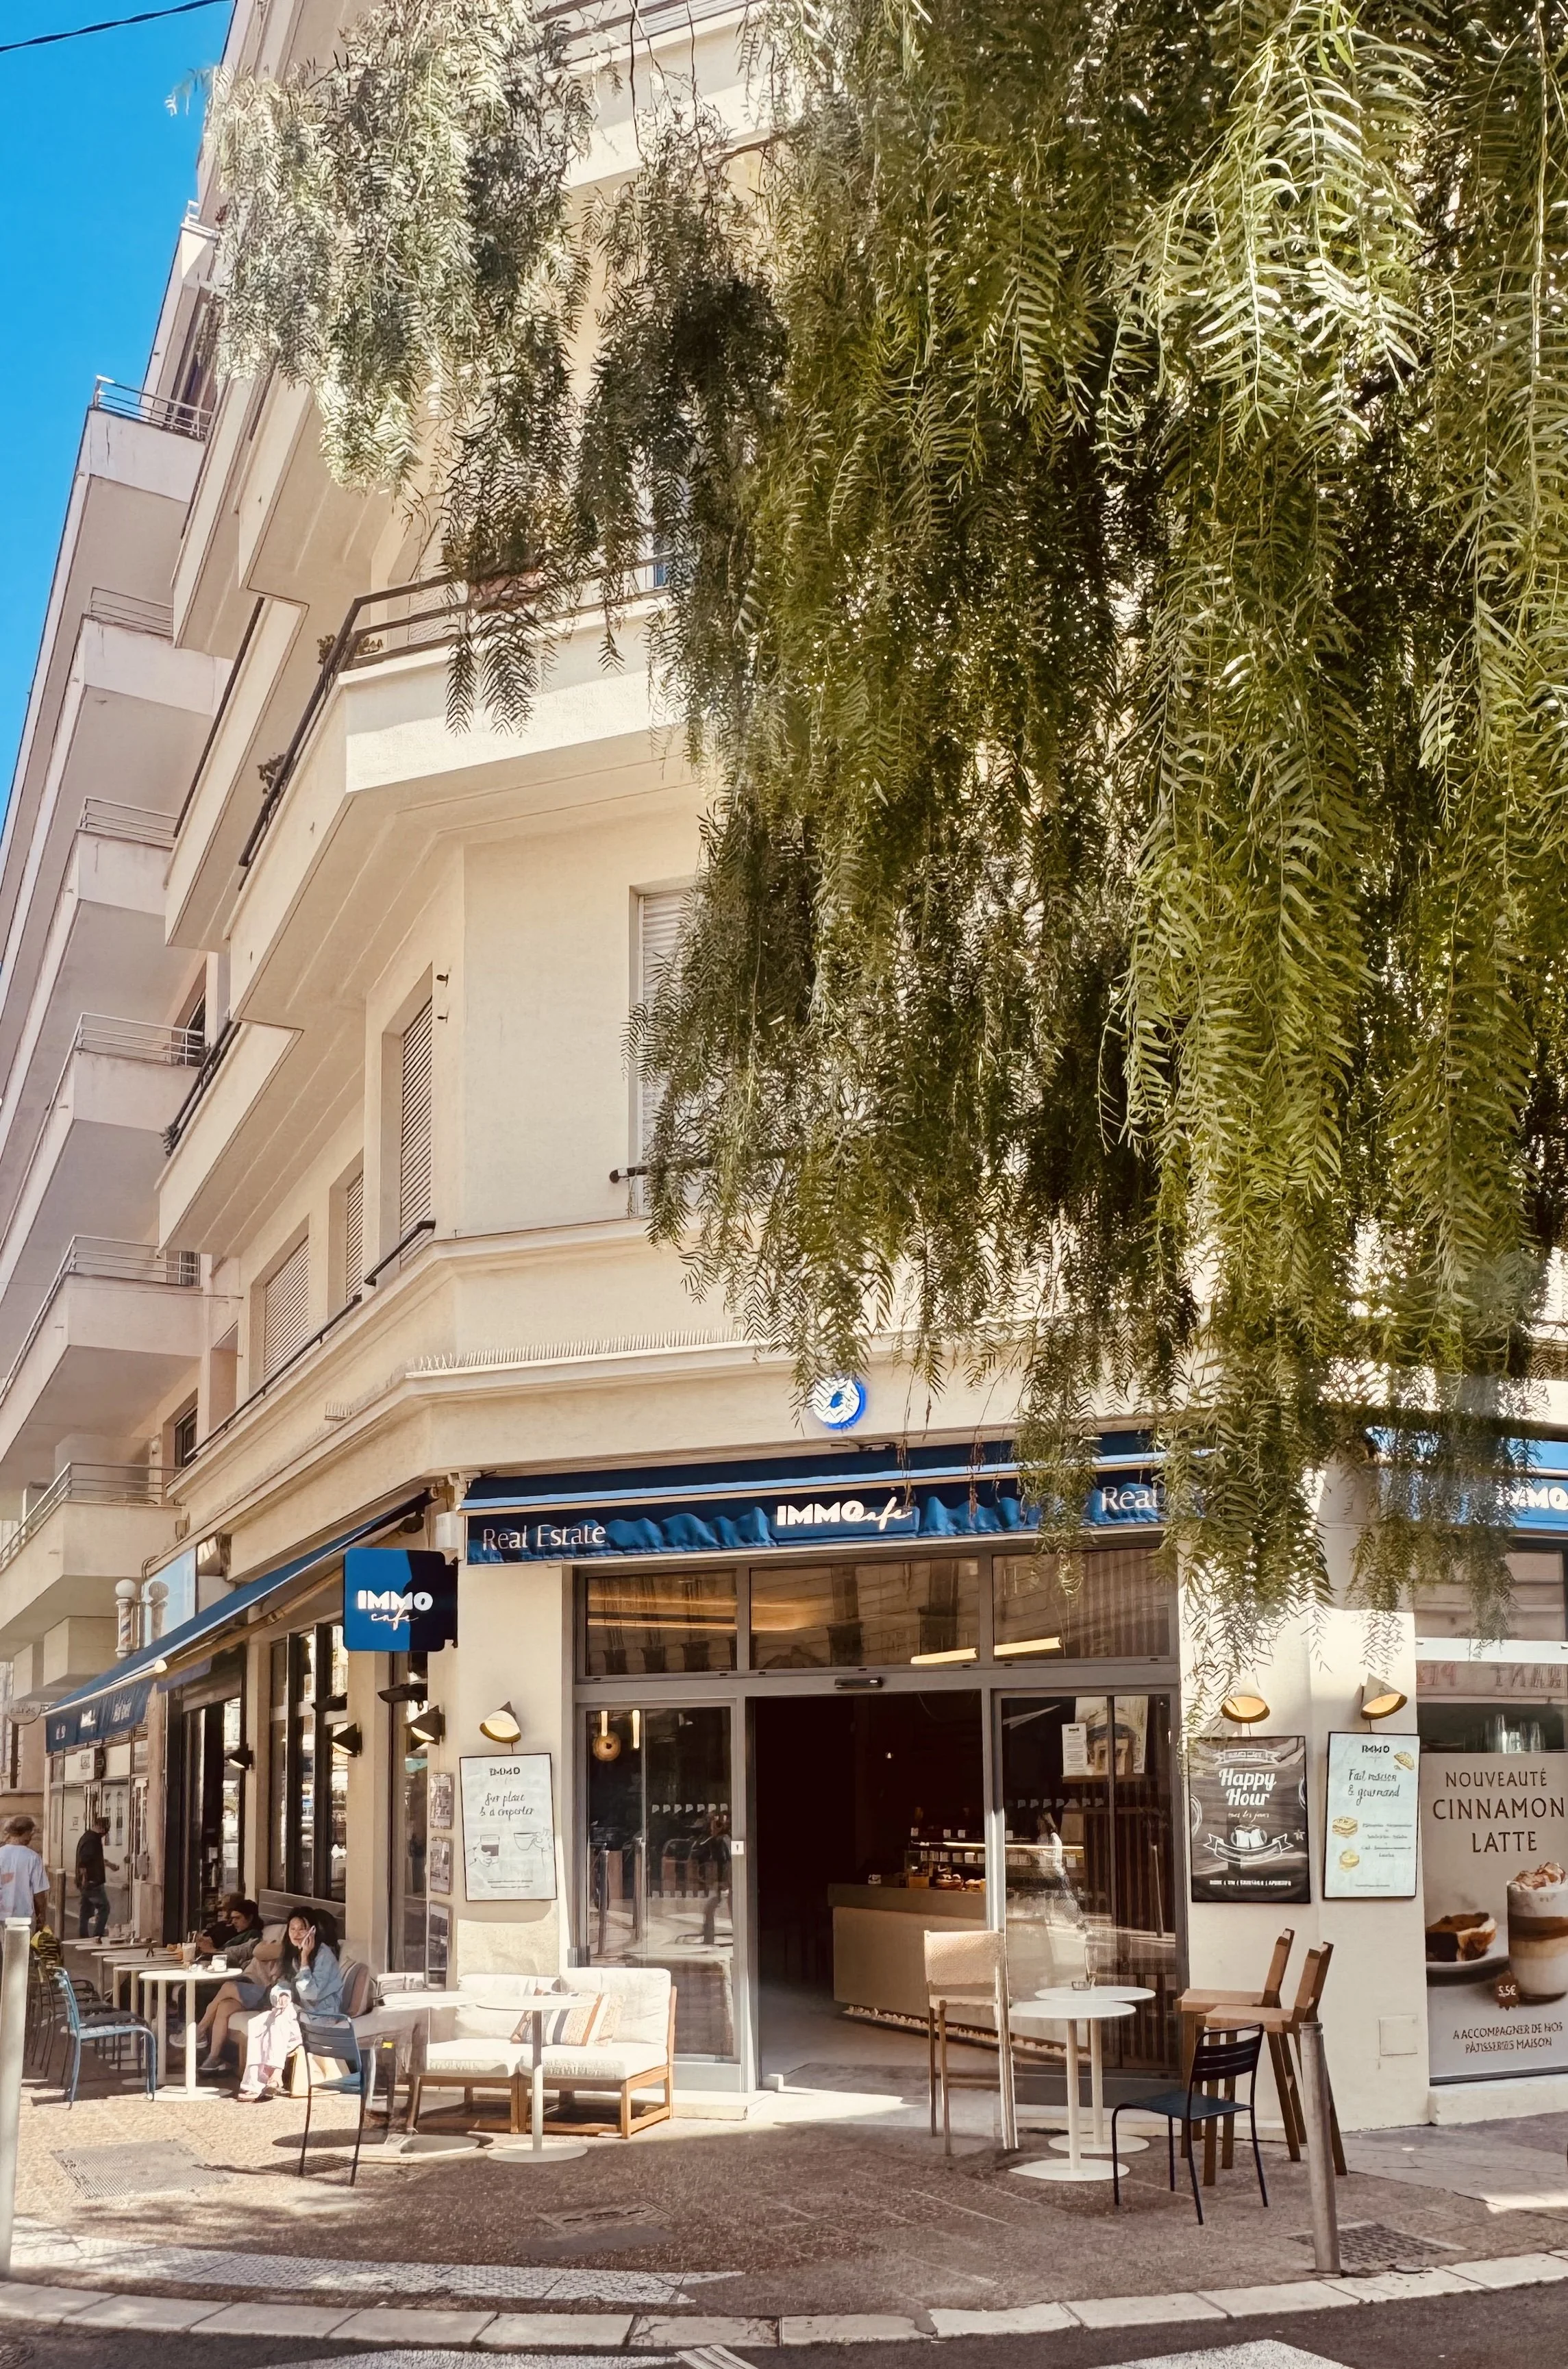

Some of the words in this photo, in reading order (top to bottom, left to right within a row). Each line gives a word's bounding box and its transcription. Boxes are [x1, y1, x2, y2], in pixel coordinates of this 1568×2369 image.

[1102, 1485, 1158, 1512] Real
[776, 1500, 865, 1526] IMMO
[482, 1525, 528, 1551] Real
[536, 1524, 607, 1548] Estate
[358, 1589, 434, 1611] IMMO
[1218, 1768, 1278, 1791] Happy
[1445, 1768, 1547, 1787] NOUVEAUTÉ
[1225, 1788, 1270, 1807] Hour
[1433, 1797, 1565, 1820] CINNAMON
[1472, 1831, 1537, 1853] LATTE
[1460, 2024, 1530, 2039] ACCOMPAGNER
[1531, 2023, 1542, 2034] DE
[1544, 2021, 1563, 2033] NOS
[1516, 2036, 1552, 2050] MAISON
